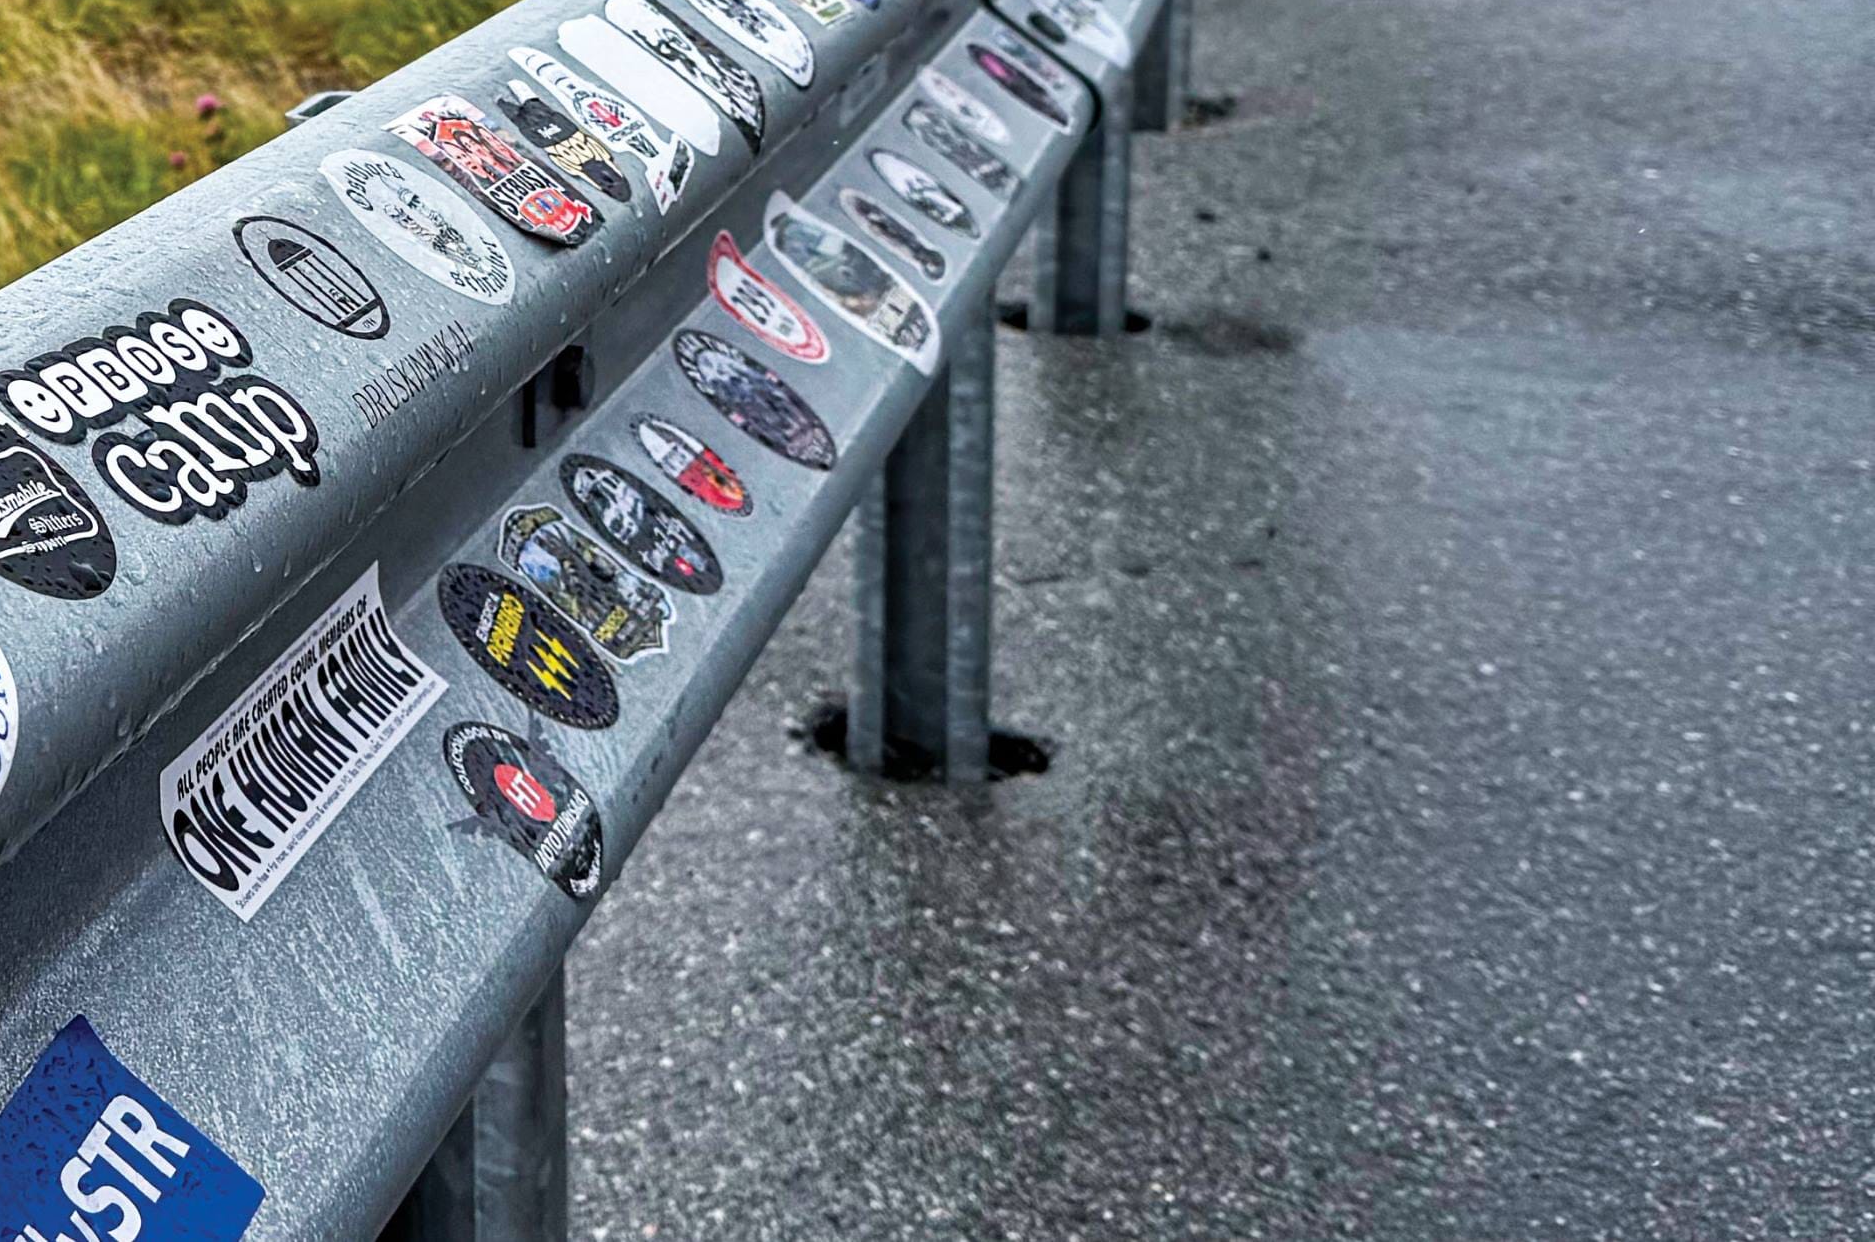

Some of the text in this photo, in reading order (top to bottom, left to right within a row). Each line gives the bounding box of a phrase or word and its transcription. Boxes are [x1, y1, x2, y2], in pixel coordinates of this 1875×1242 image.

[174, 771, 276, 892] ONE
[228, 680, 359, 834] HUMAN
[317, 606, 425, 740] FAMILY
[176, 594, 369, 802] ALL PEOPLE ARE CREATED EQUAL MEMBERS OF
[507, 768, 542, 817] HT
[533, 830, 563, 874] MOTO
